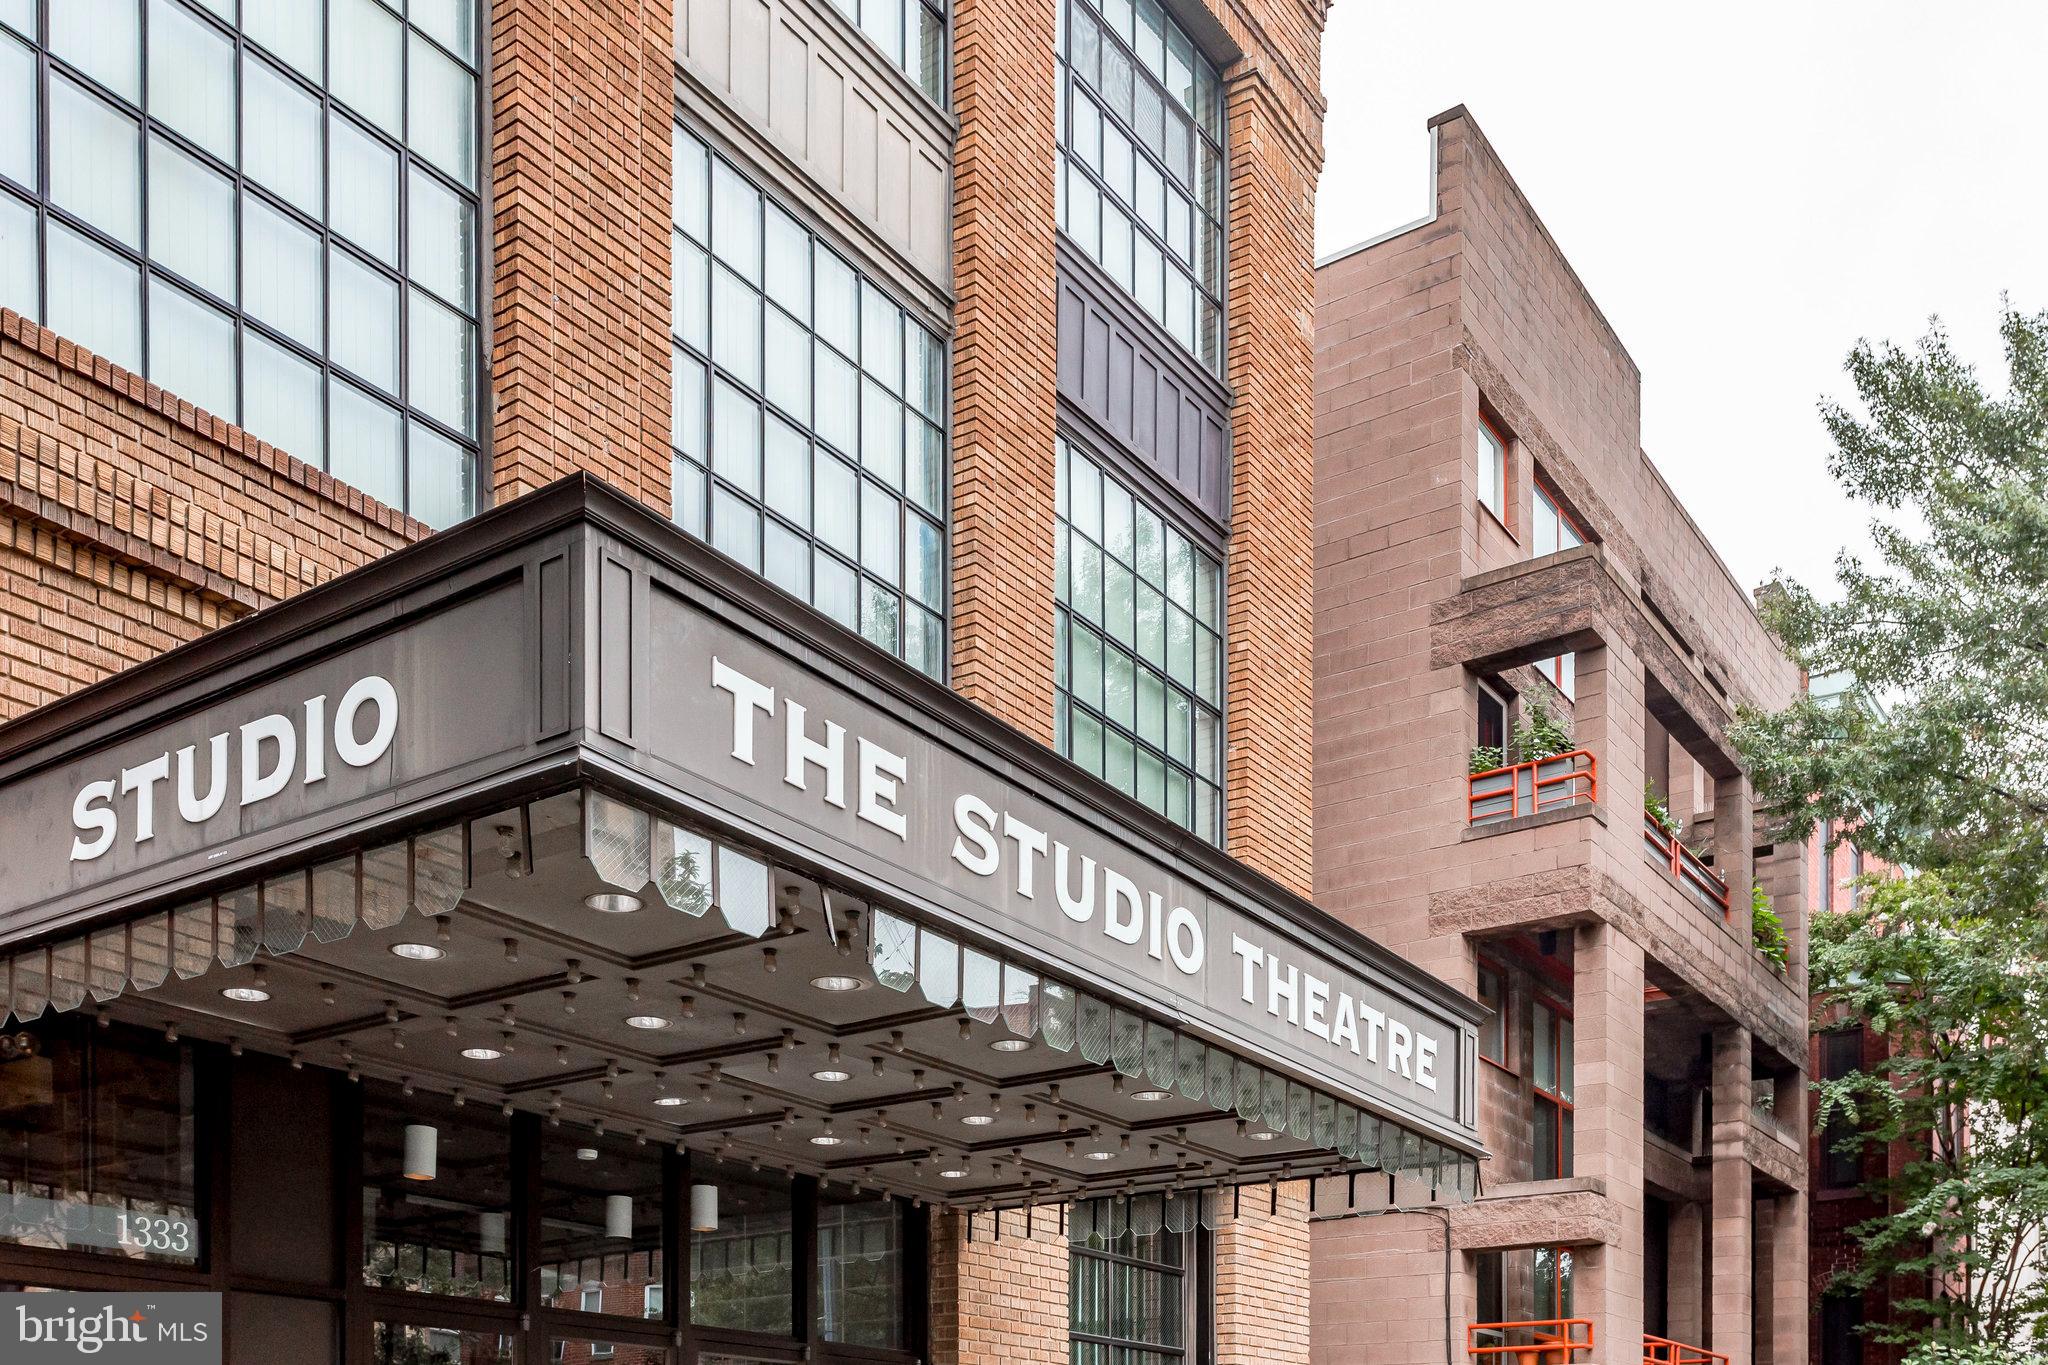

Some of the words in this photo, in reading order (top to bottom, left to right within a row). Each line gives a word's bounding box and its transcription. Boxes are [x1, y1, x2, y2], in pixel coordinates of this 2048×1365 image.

[70, 675, 399, 861] STUDIO
[711, 655, 907, 841] THE
[951, 793, 1205, 975] STUDIO
[1232, 932, 1439, 1095] THEATRE
[116, 1214, 189, 1251] 1333
